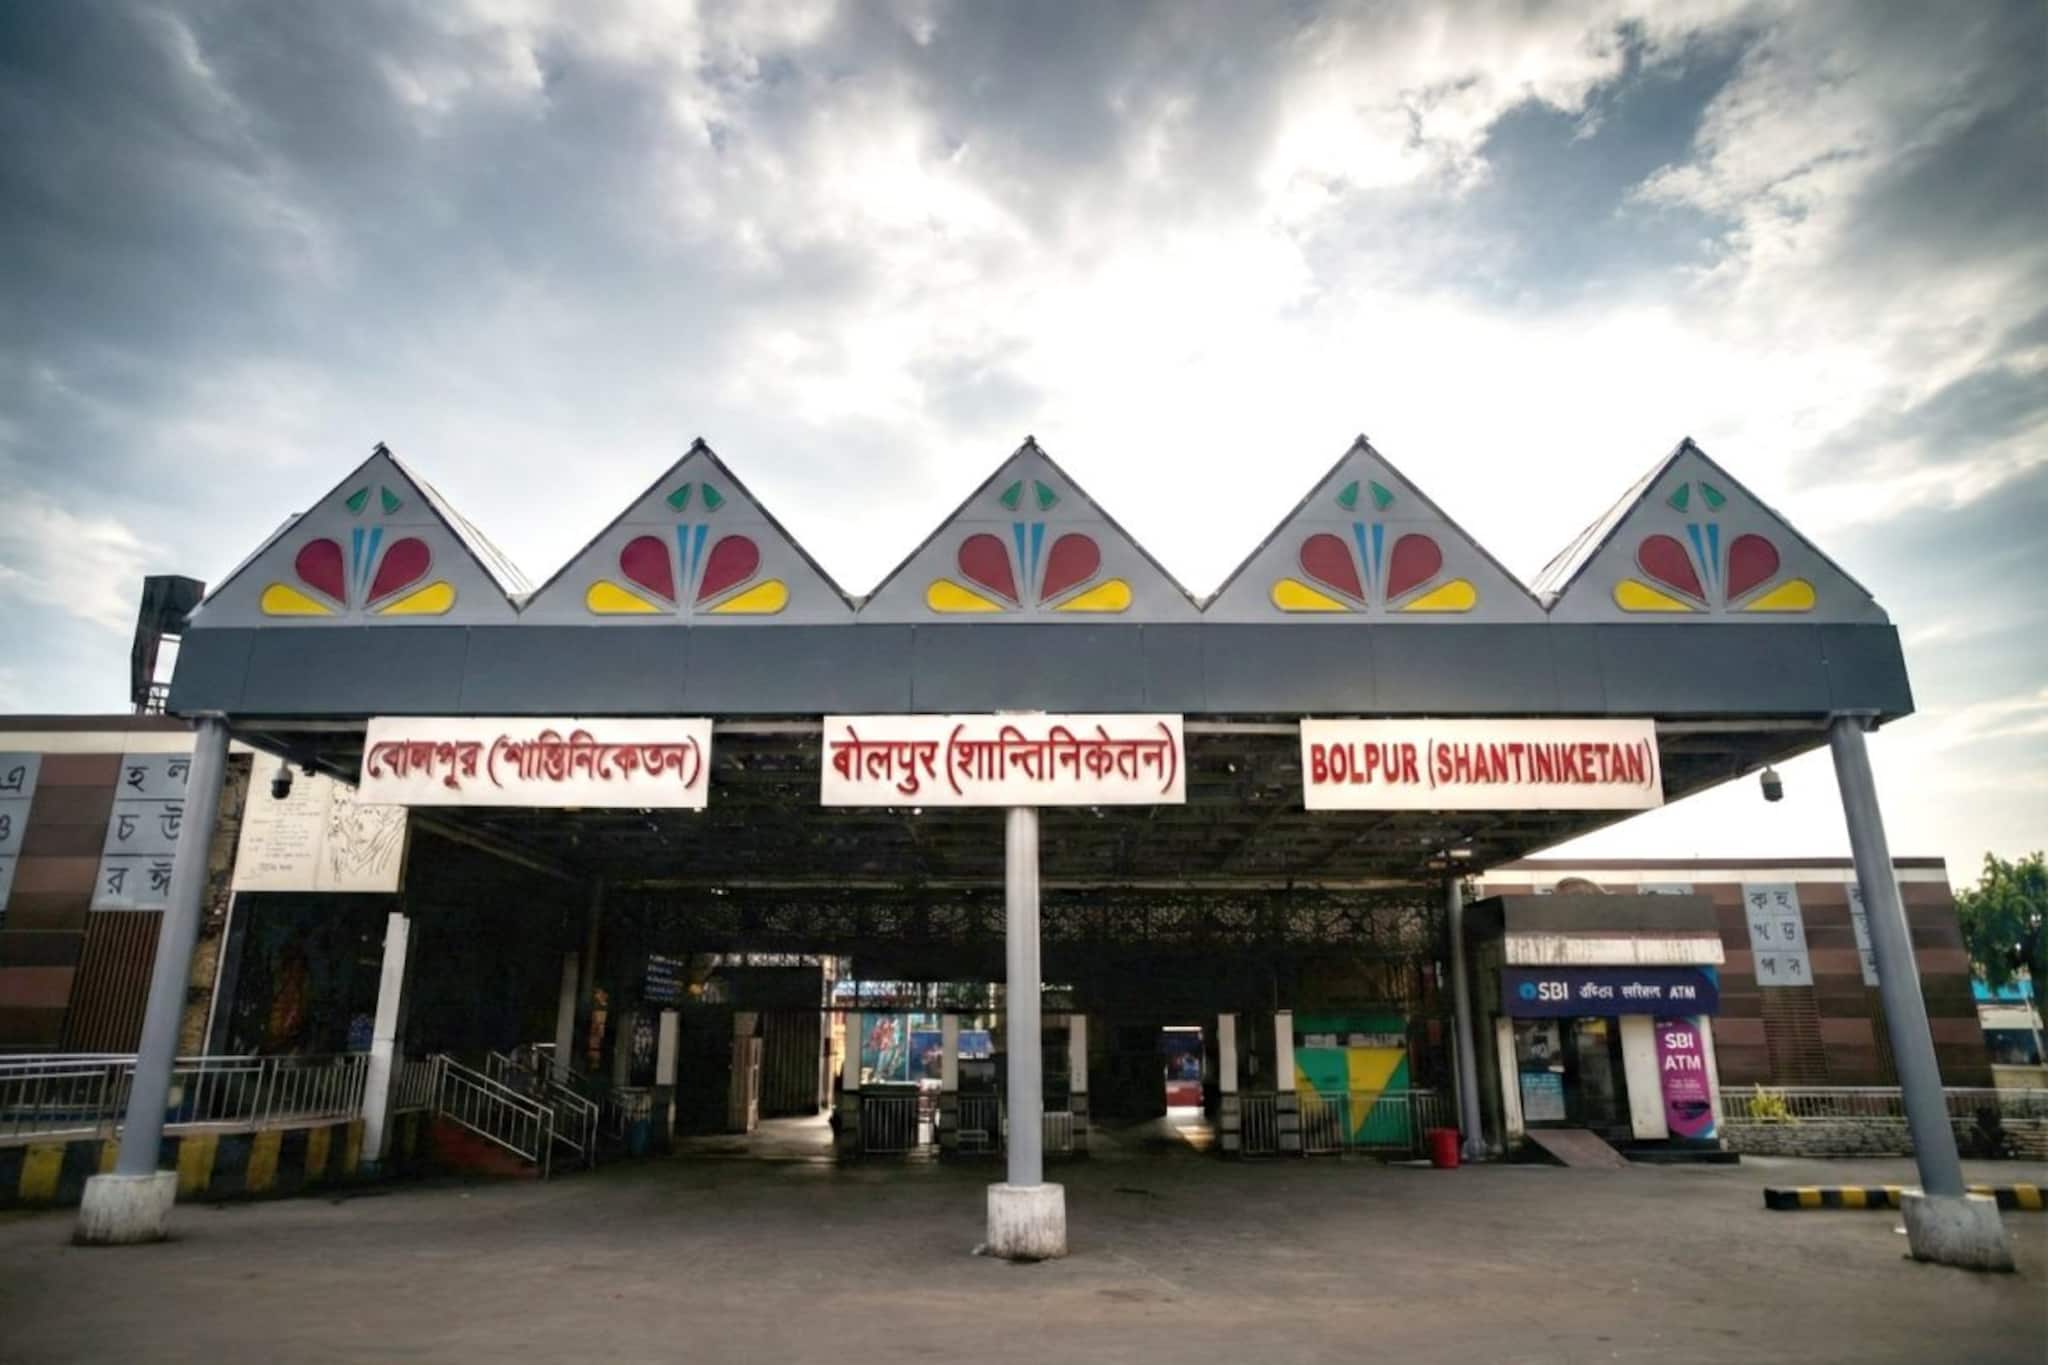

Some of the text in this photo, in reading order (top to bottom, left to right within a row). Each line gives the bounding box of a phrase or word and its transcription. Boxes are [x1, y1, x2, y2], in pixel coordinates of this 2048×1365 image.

[367, 729, 702, 789] বোলপুর (শান্তিনিকেতন)
[830, 722, 1177, 795] बोलपुर (शान्तिनिकेतन)
[1310, 737, 1655, 790] BOLPUR (SHANTINIKETAN)
[1538, 981, 1568, 1000] SBI
[1669, 985, 1696, 999] ATM
[1664, 1032, 1694, 1049] SBI
[1664, 1055, 1701, 1070] ATM
